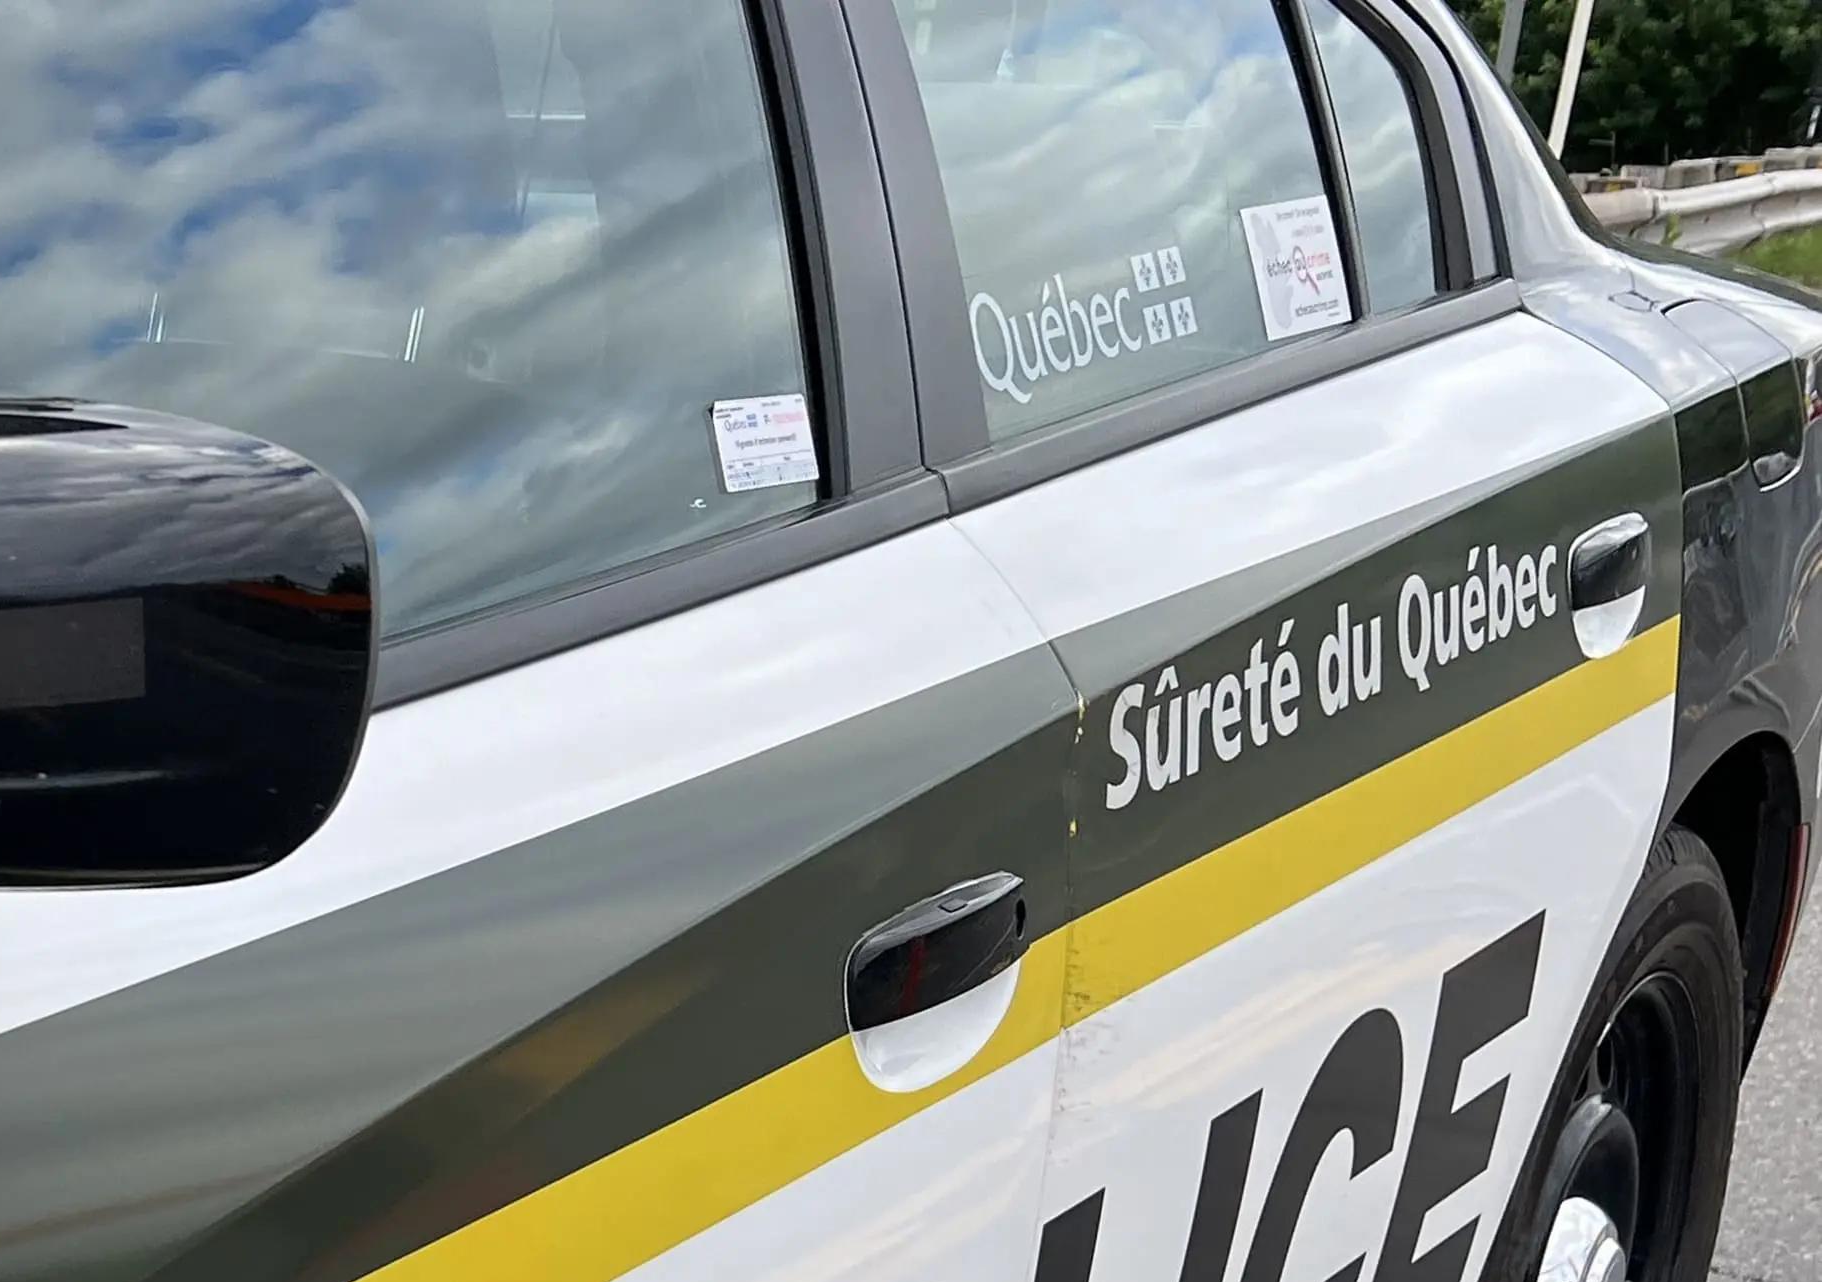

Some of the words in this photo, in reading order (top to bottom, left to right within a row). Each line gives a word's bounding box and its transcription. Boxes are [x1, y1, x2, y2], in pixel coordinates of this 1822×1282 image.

[968, 272, 1144, 405] Québec
[1105, 617, 1301, 811] Sûreté
[1317, 602, 1382, 717] du
[1397, 544, 1558, 693] Québec
